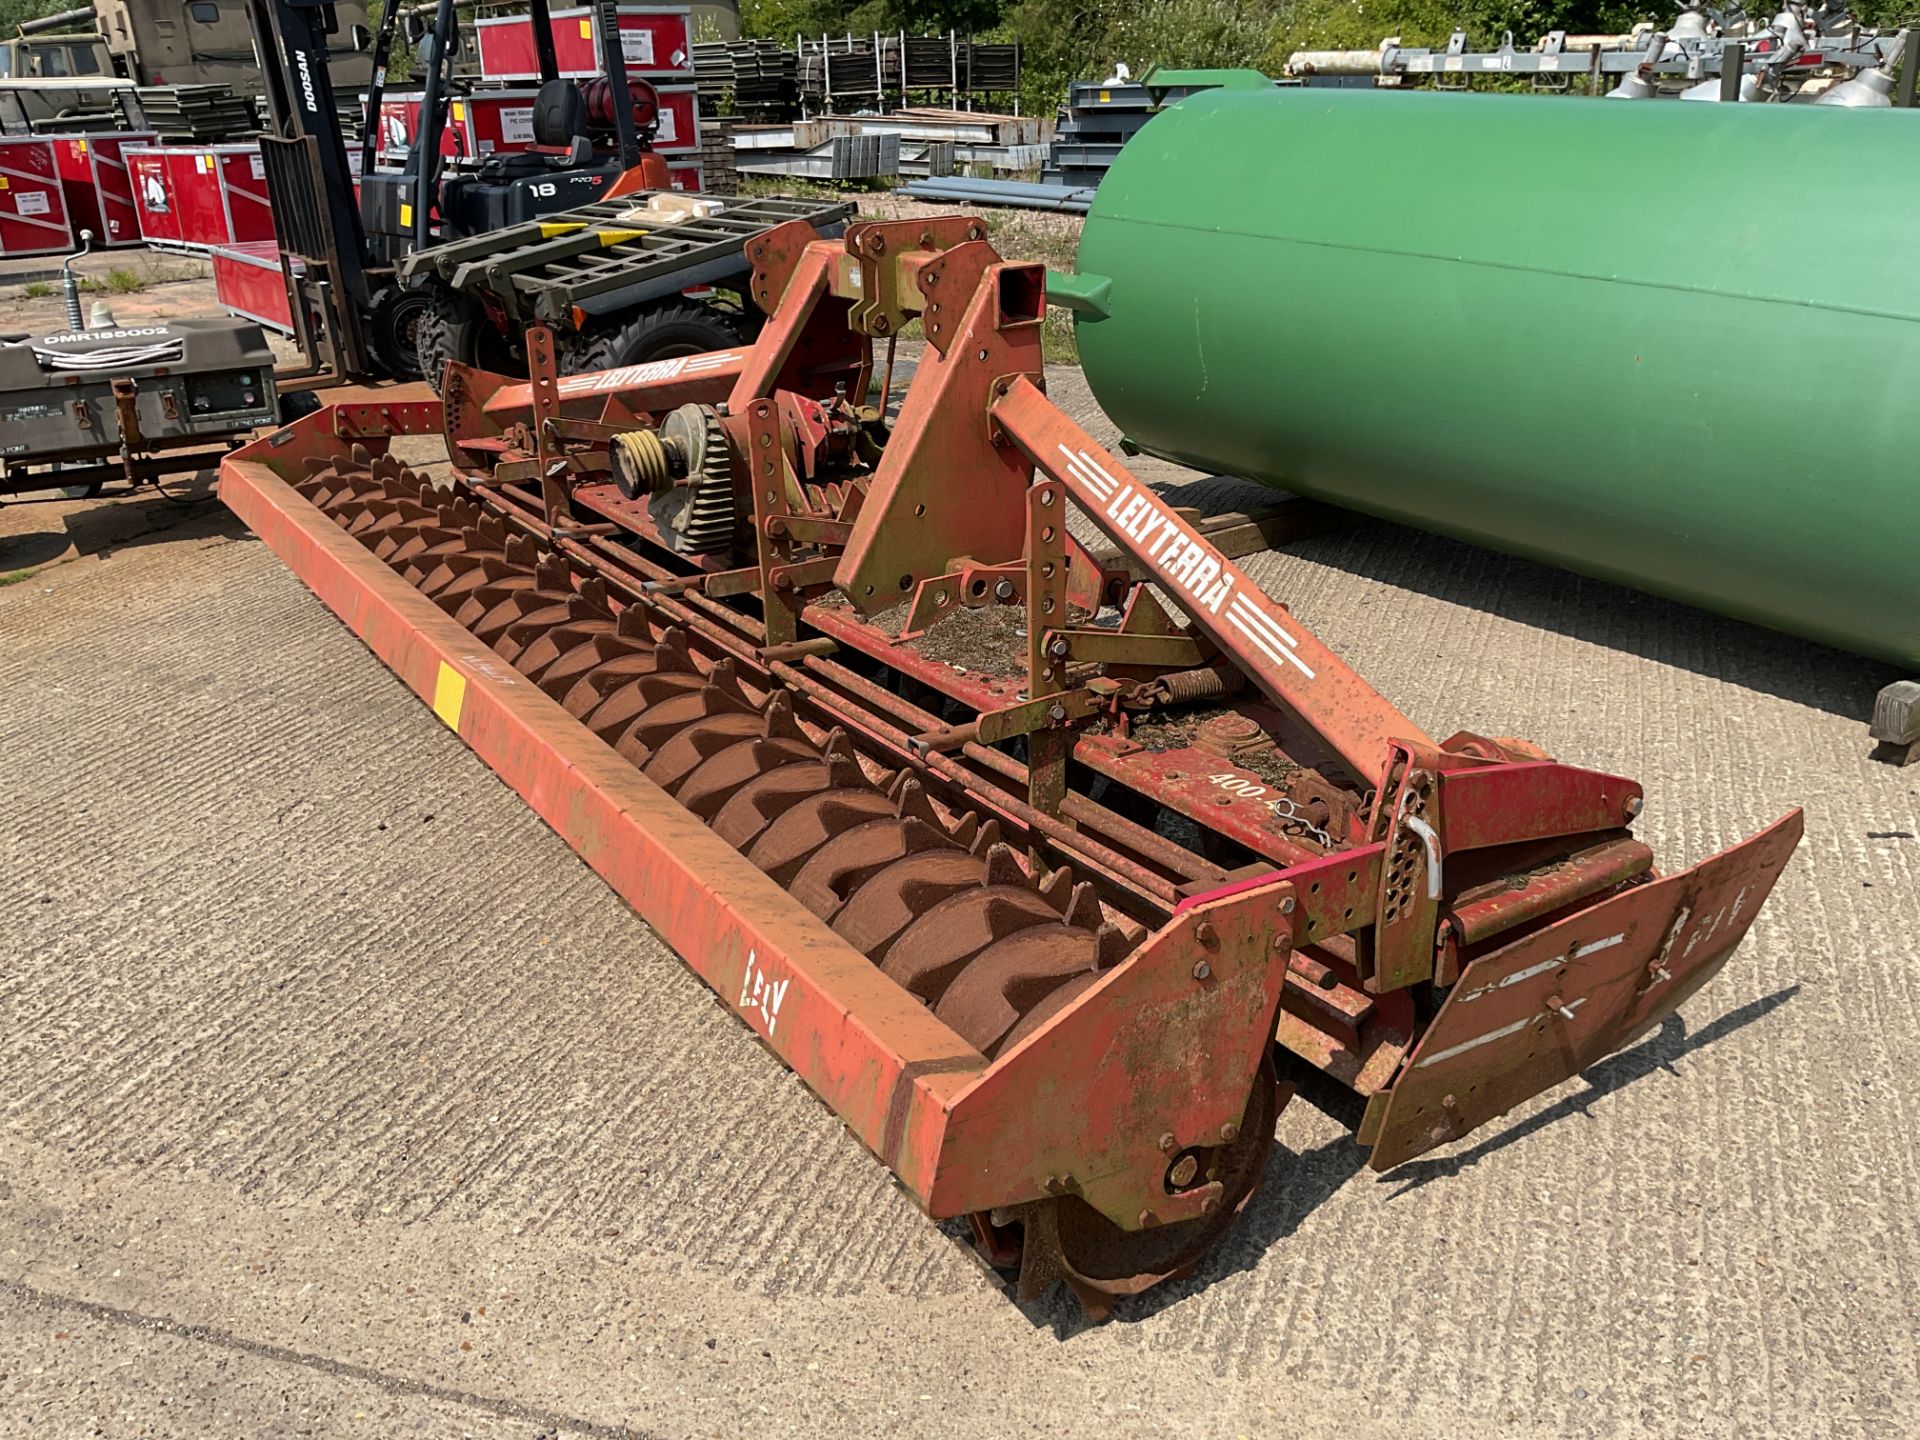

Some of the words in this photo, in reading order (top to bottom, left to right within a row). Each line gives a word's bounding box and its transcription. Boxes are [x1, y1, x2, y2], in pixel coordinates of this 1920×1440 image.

[295, 50, 317, 112] DOOSAN
[528, 182, 557, 198] 18
[44, 327, 169, 345] DMR185002
[594, 357, 689, 391] LELYTERRA
[1106, 484, 1235, 614] LELYTERRA
[739, 948, 790, 1037] LELY
